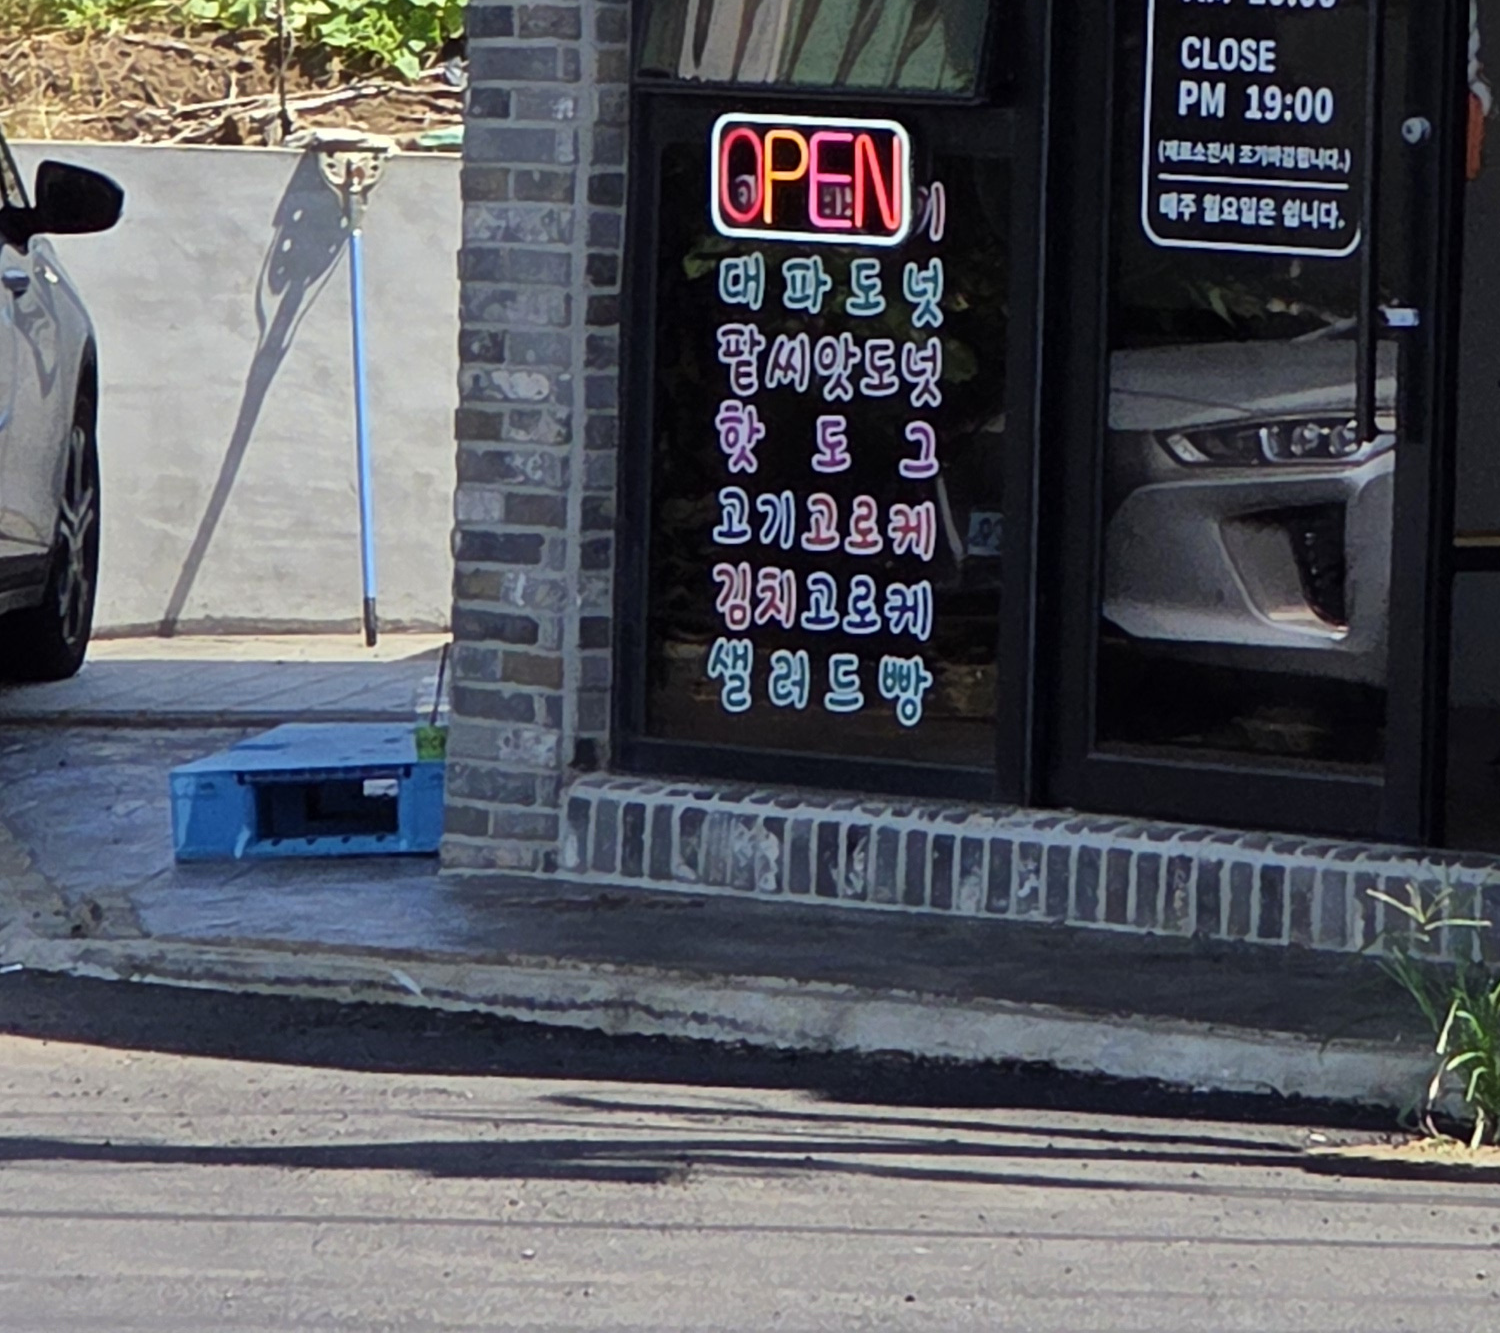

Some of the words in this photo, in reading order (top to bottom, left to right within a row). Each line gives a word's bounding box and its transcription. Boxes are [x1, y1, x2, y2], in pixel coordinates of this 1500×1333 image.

[1180, 36, 1276, 73] CLOSE
[1177, 80, 1225, 118] PM
[1244, 85, 1334, 124] 19:00
[719, 126, 903, 231] OPEN
[1158, 191, 1197, 222] 매주
[1203, 193, 1277, 226] 월요일은
[716, 323, 943, 407] 팥씨앗도넛
[711, 485, 937, 562] 고기고로케
[711, 562, 933, 641] 김치고로케
[707, 636, 933, 726] 샐러드빵
